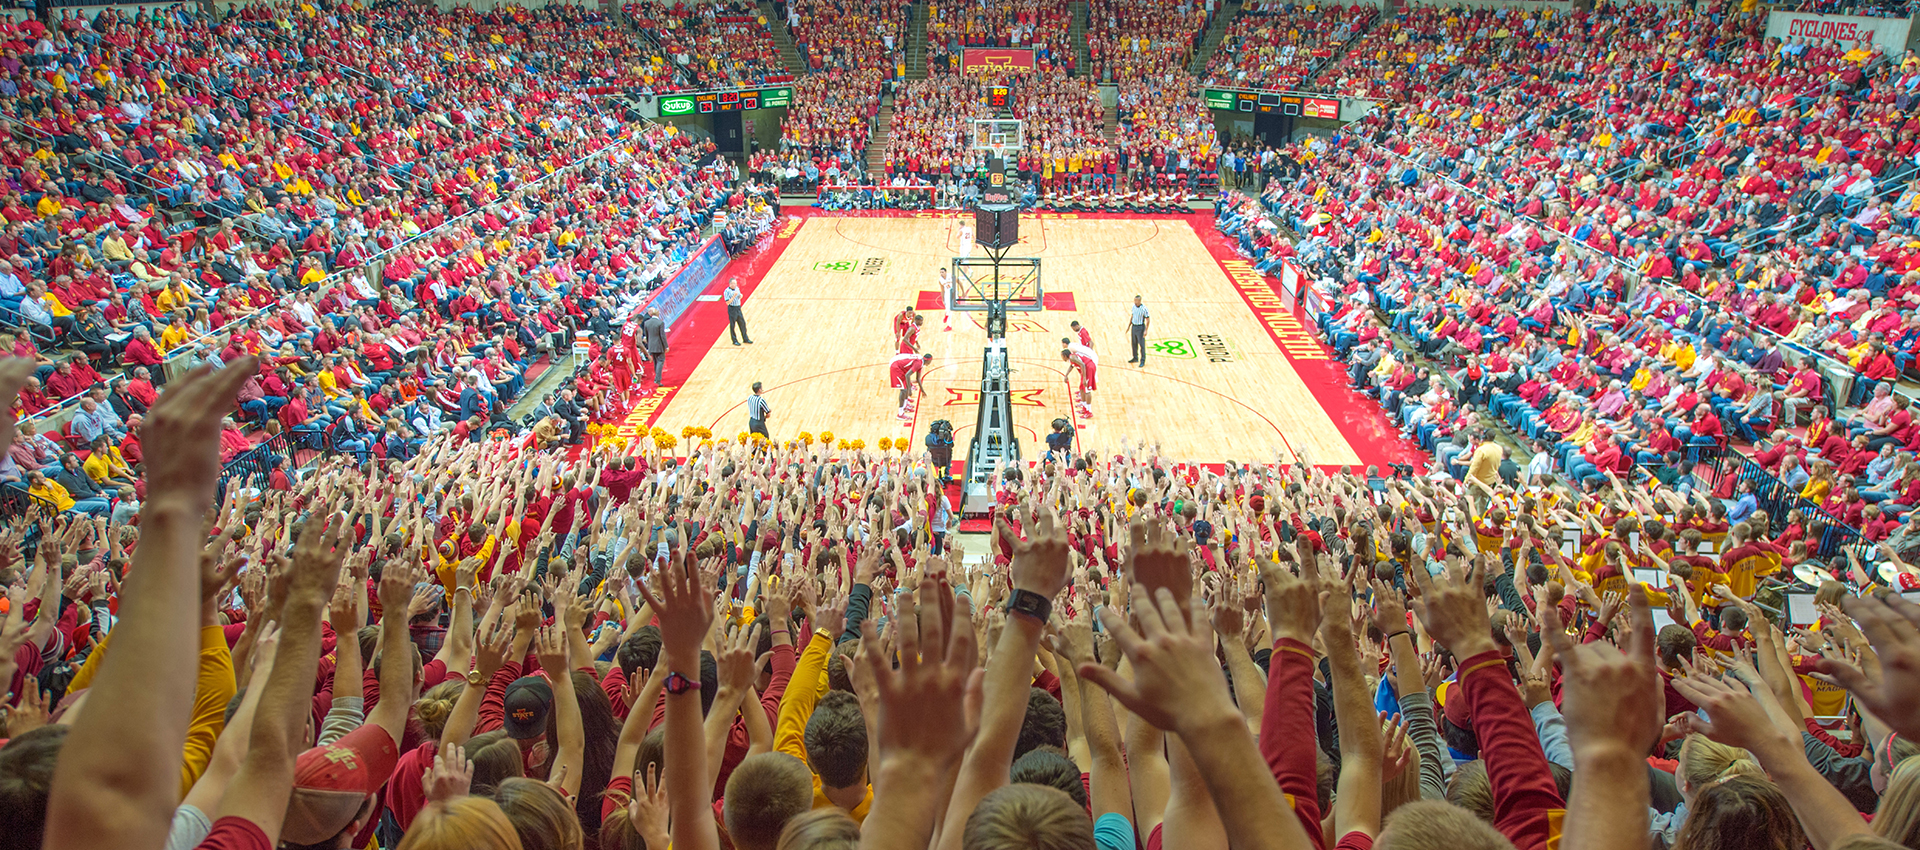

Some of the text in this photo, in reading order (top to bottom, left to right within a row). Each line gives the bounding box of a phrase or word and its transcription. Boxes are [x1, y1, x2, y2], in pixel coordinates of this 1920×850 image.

[722, 92, 739, 102] 8:20
[992, 94, 1005, 105] 35
[664, 100, 691, 109] Sukup
[702, 102, 712, 111] 34
[746, 99, 756, 108] 20
[1221, 259, 1330, 360] HILTON COLISEUM
[622, 325, 635, 337] 33
[1197, 334, 1234, 362] PIONEER
[616, 352, 624, 361] 4
